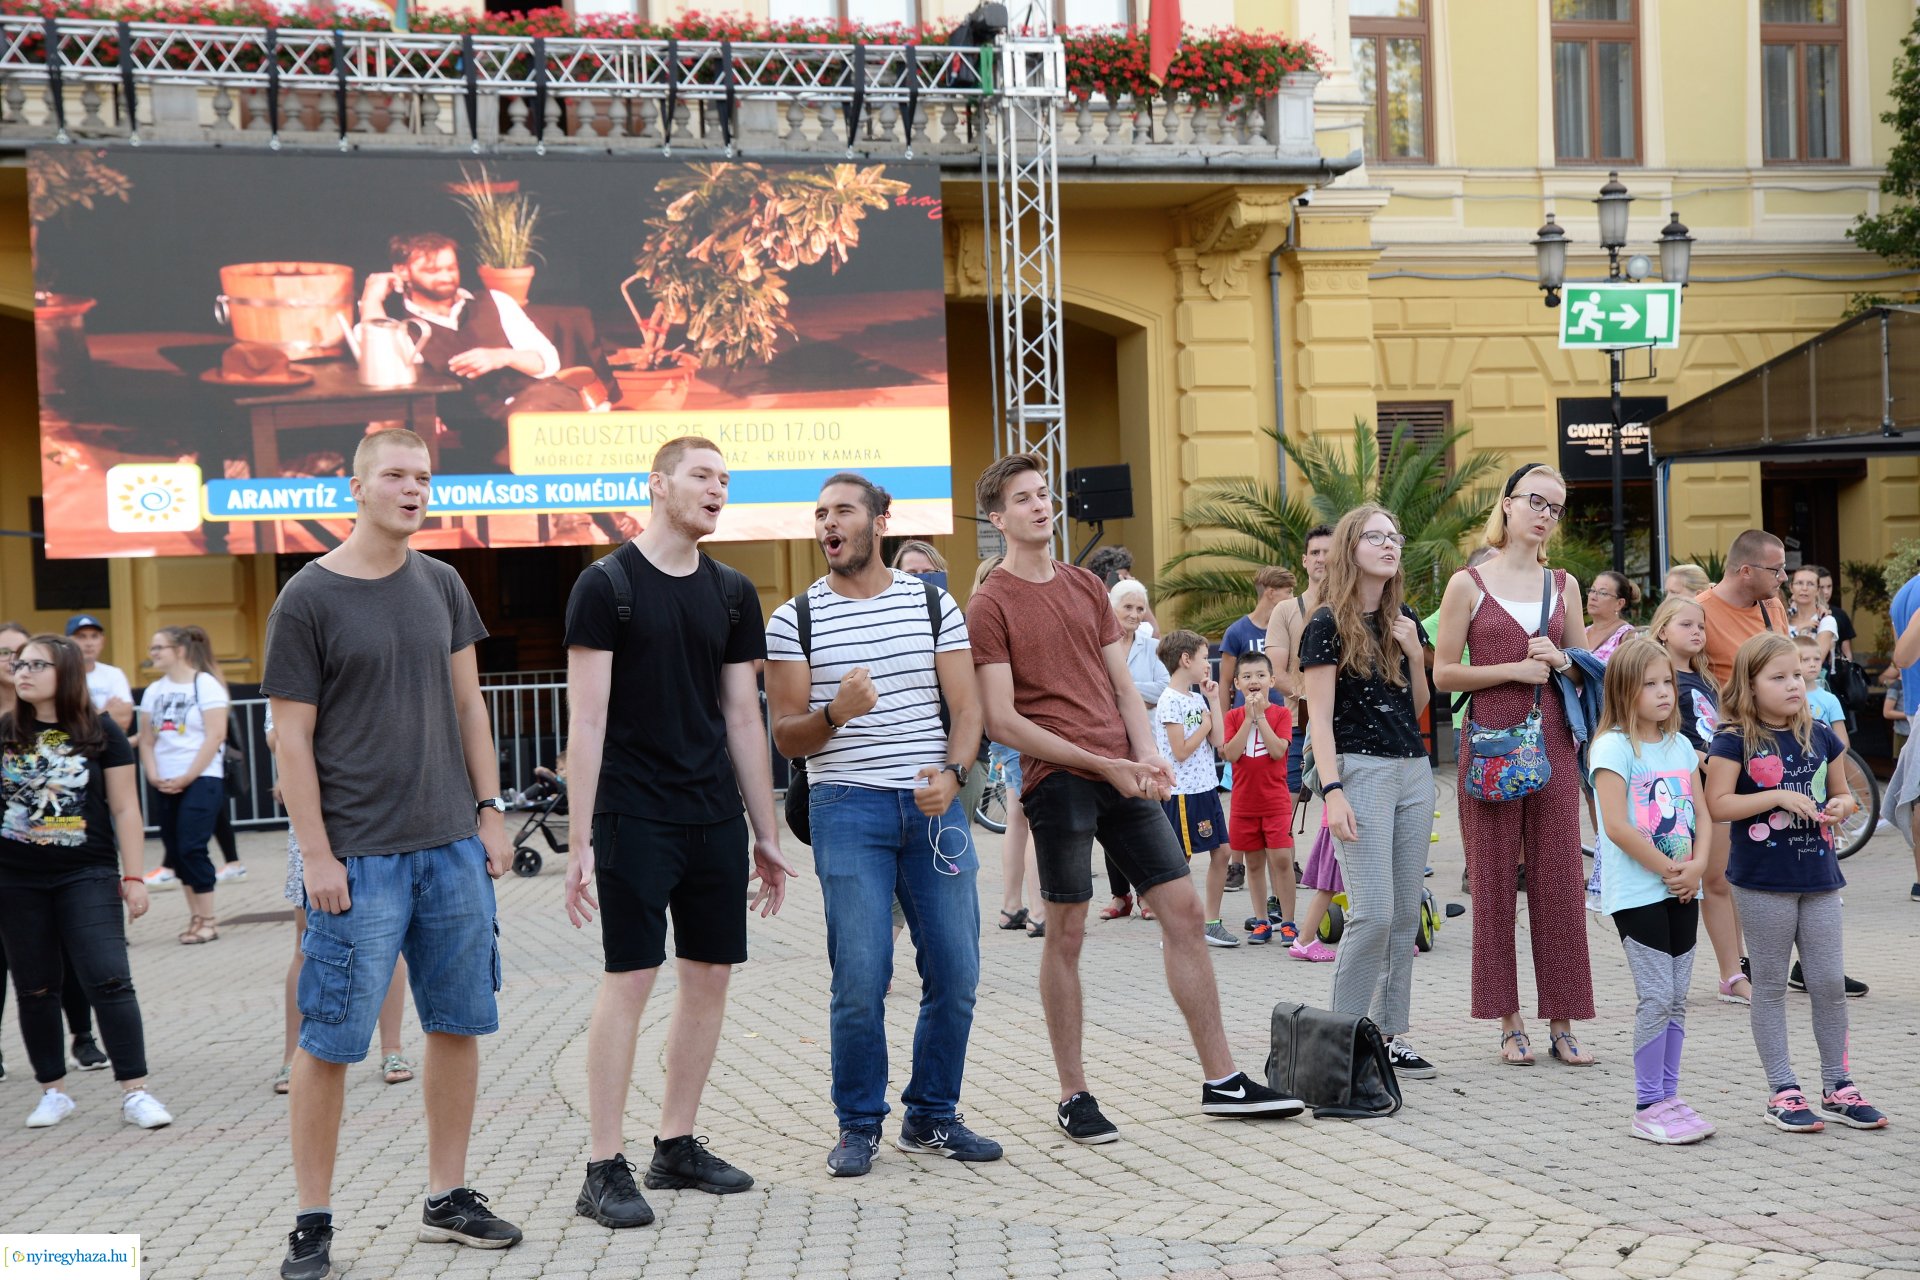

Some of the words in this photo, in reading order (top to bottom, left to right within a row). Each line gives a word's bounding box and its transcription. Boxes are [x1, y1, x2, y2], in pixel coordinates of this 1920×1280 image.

[534, 424, 668, 446] AUGUSZTUS
[719, 422, 775, 443] KEDD
[784, 421, 840, 441] 17.00
[534, 452, 593, 467] MÓRICZ
[767, 449, 816, 462] KRÚDY
[823, 448, 882, 461] KAMARA
[226, 483, 338, 509] ARANYTÍZ
[428, 480, 539, 506] LVONÁSOS
